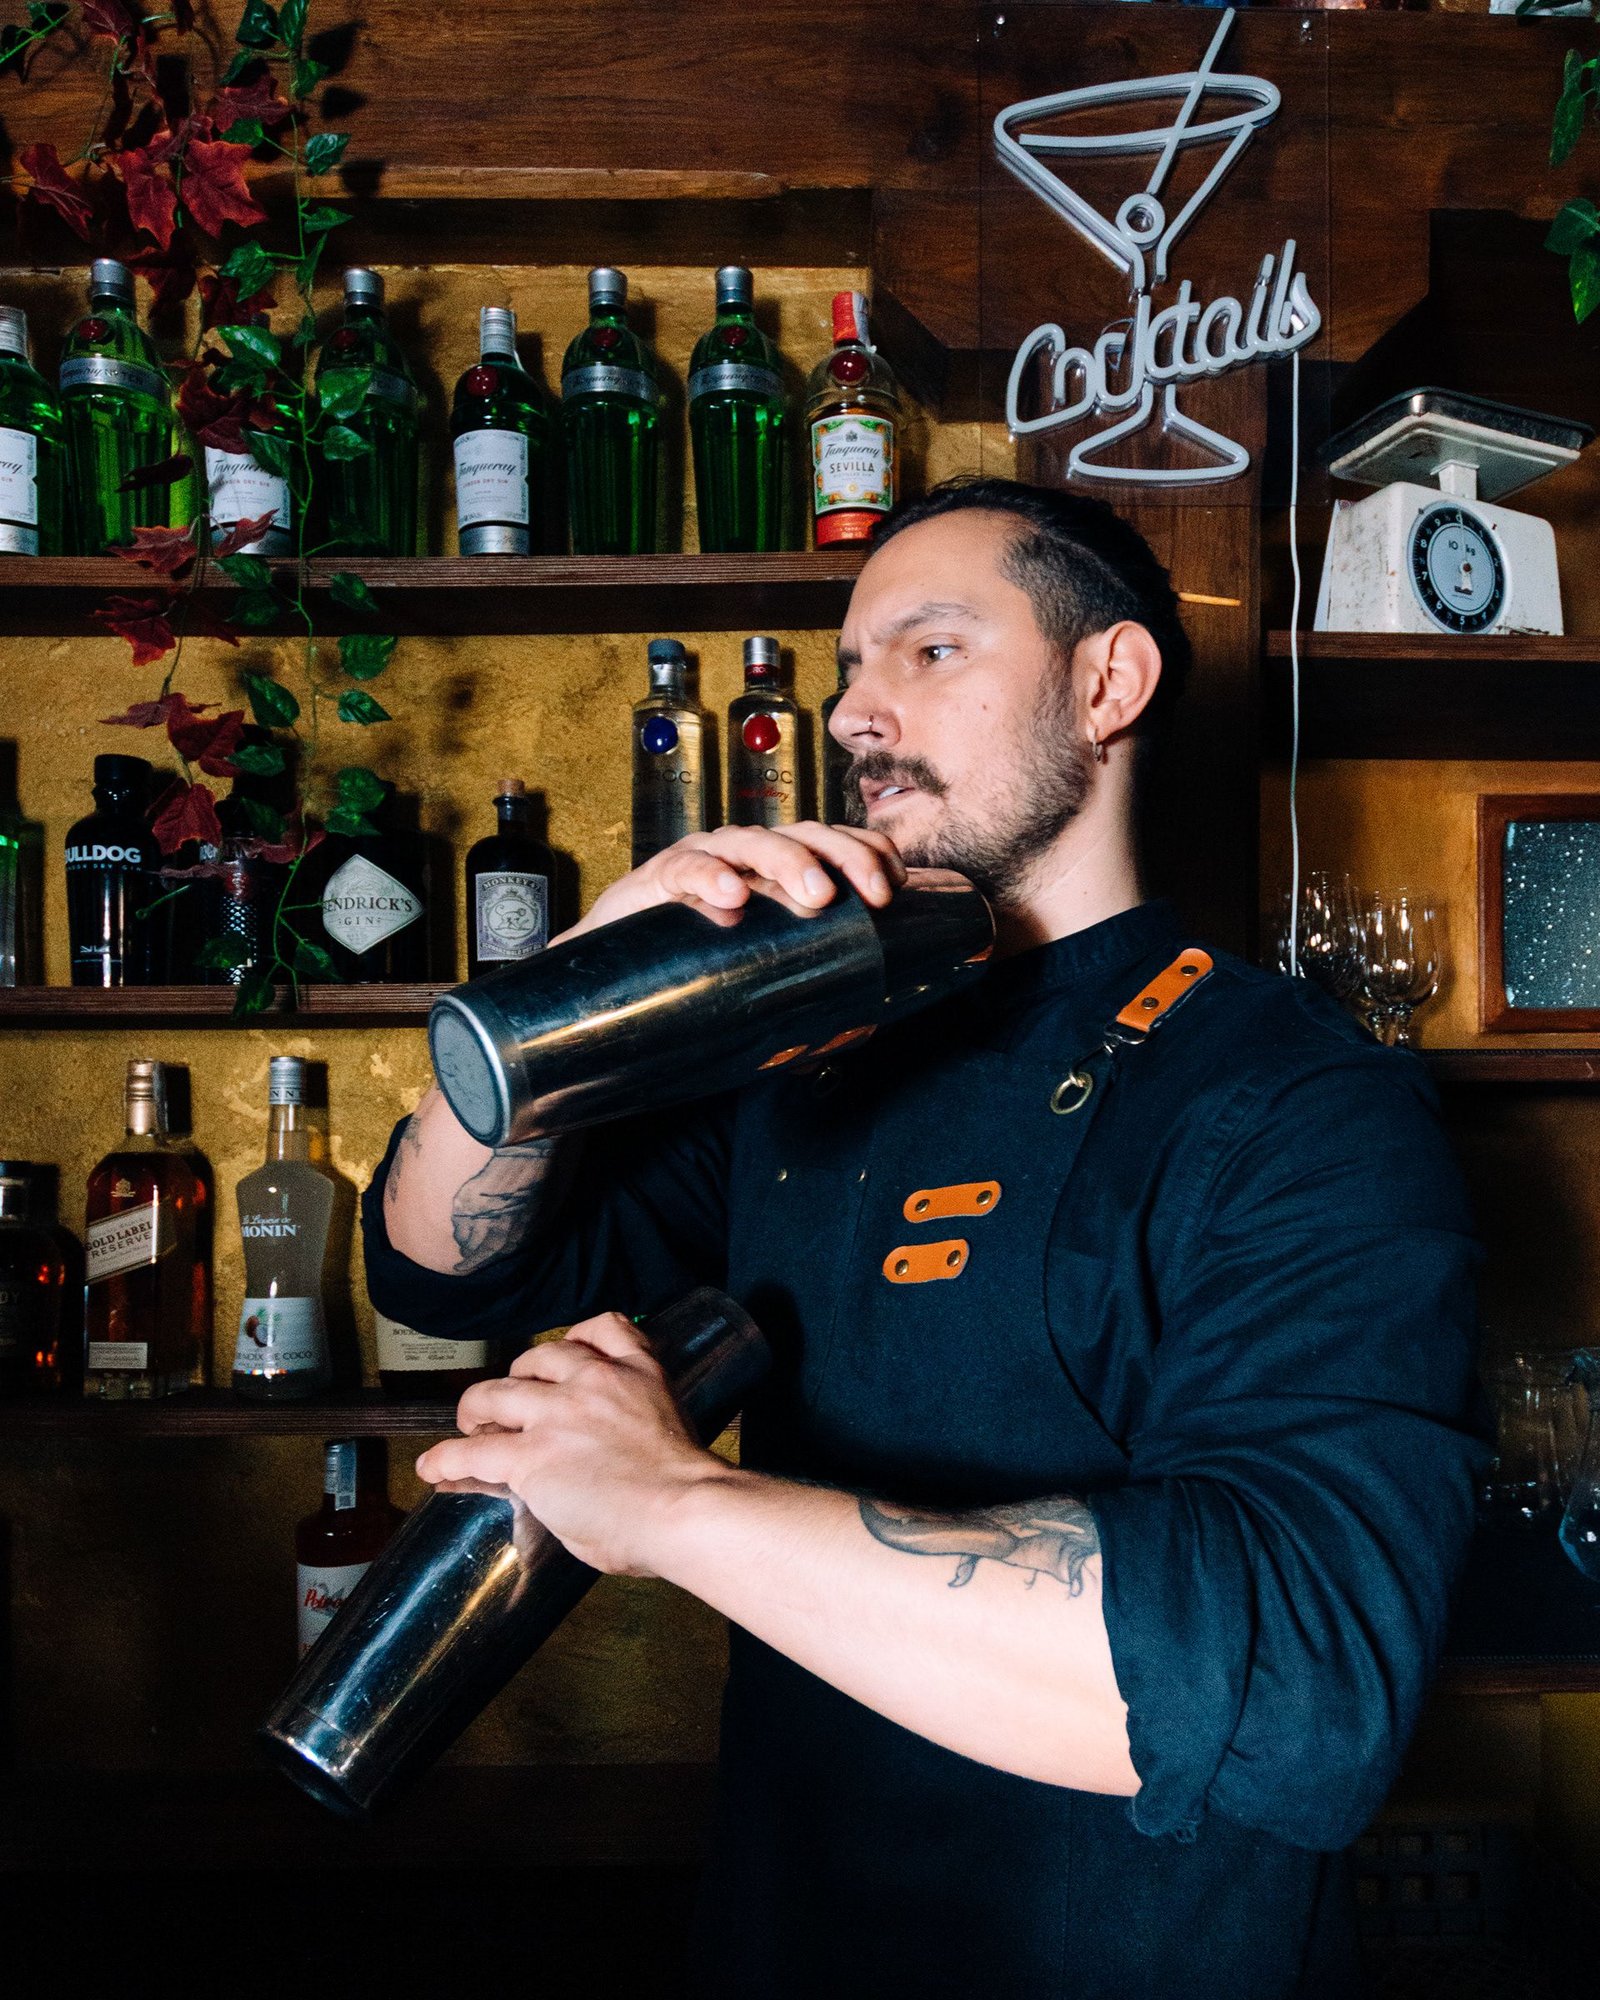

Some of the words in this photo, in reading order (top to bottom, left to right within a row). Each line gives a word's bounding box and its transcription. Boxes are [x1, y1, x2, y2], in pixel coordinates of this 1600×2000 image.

[1006, 239, 1321, 434] Cocktails
[824, 444, 879, 459] Tanqueray
[459, 462, 516, 477] Tanqueray
[829, 463, 875, 474] SEVILLA
[1448, 540, 1459, 551] 10
[121, 864, 143, 872] GIN
[482, 876, 528, 892] MONKEY
[323, 896, 413, 913] ENDRICK'S
[343, 916, 374, 926] GIN
[85, 1234, 115, 1252] GOLD
[116, 1221, 153, 1240] LABEL
[241, 1224, 297, 1238] MONIN
[91, 1231, 151, 1259] RESERVE
[283, 1350, 312, 1361] COCO
